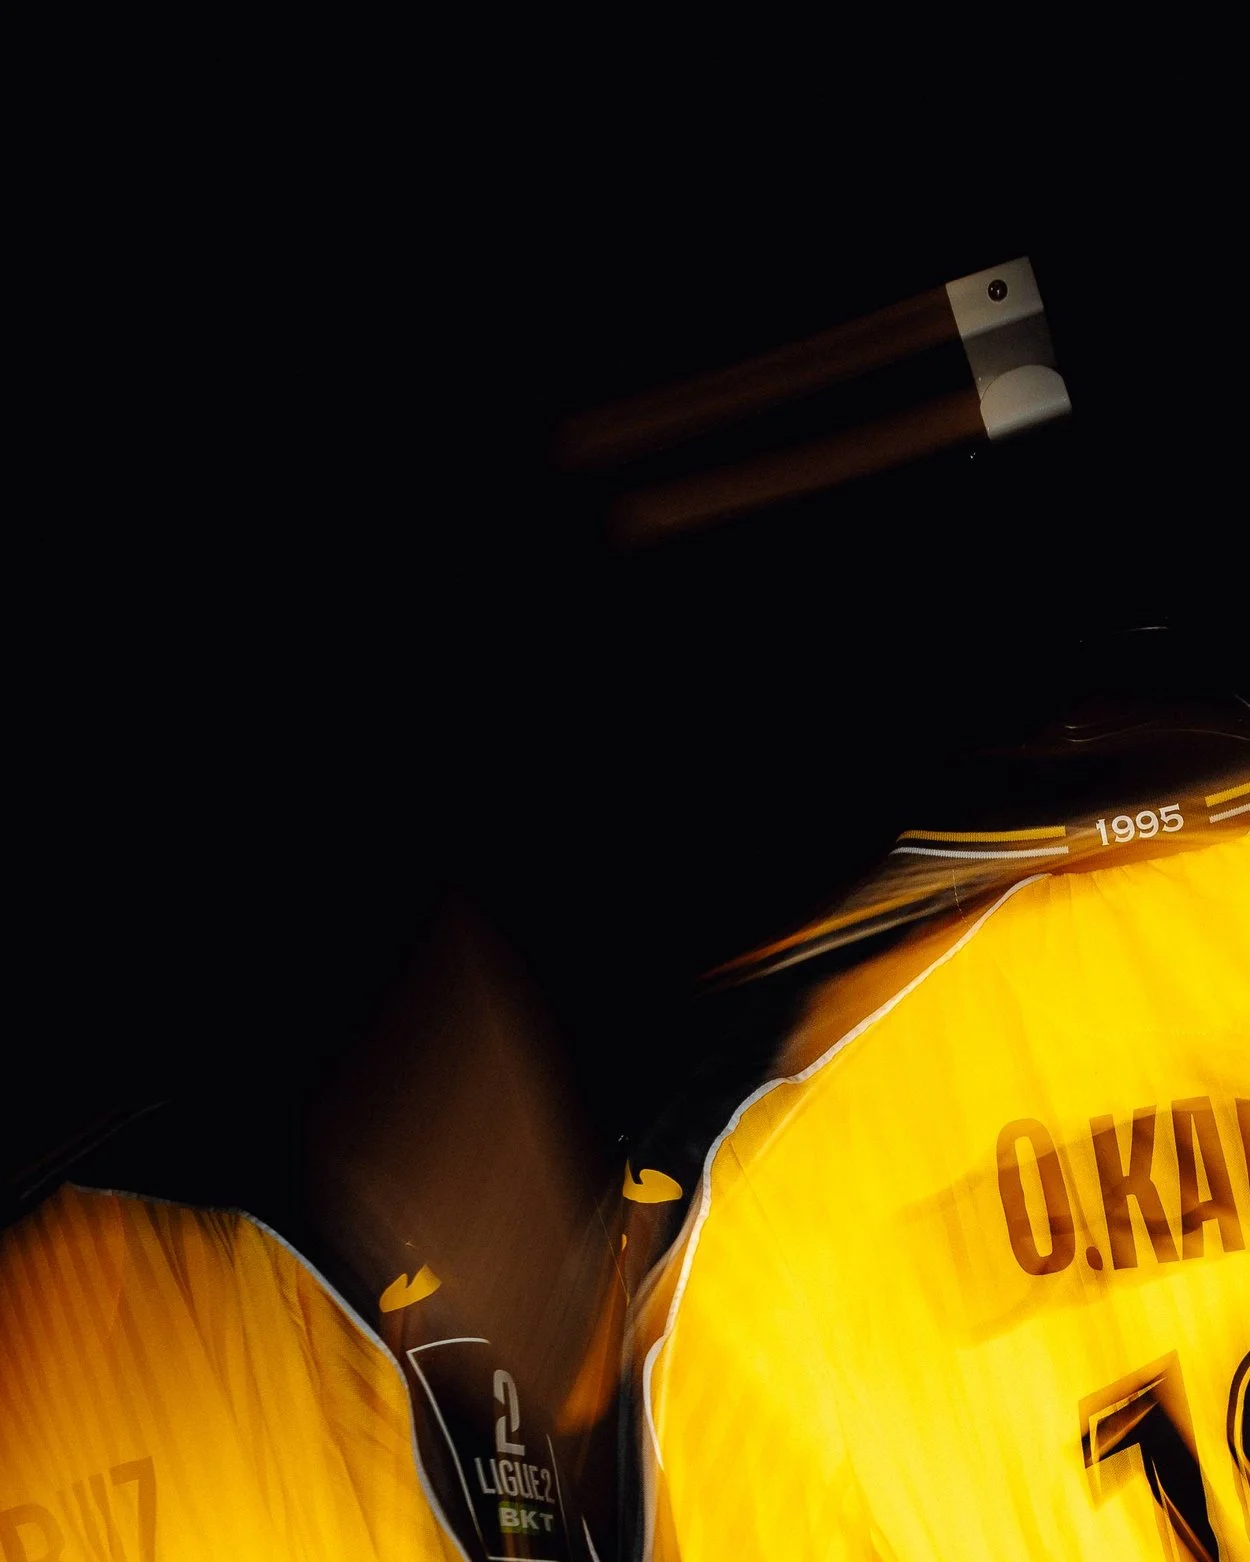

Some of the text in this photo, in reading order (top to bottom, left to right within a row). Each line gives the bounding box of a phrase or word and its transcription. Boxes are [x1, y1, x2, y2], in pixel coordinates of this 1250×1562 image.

[1096, 804, 1185, 846] 1995
[493, 1369, 526, 1457] 2
[500, 1507, 555, 1533] BKT
